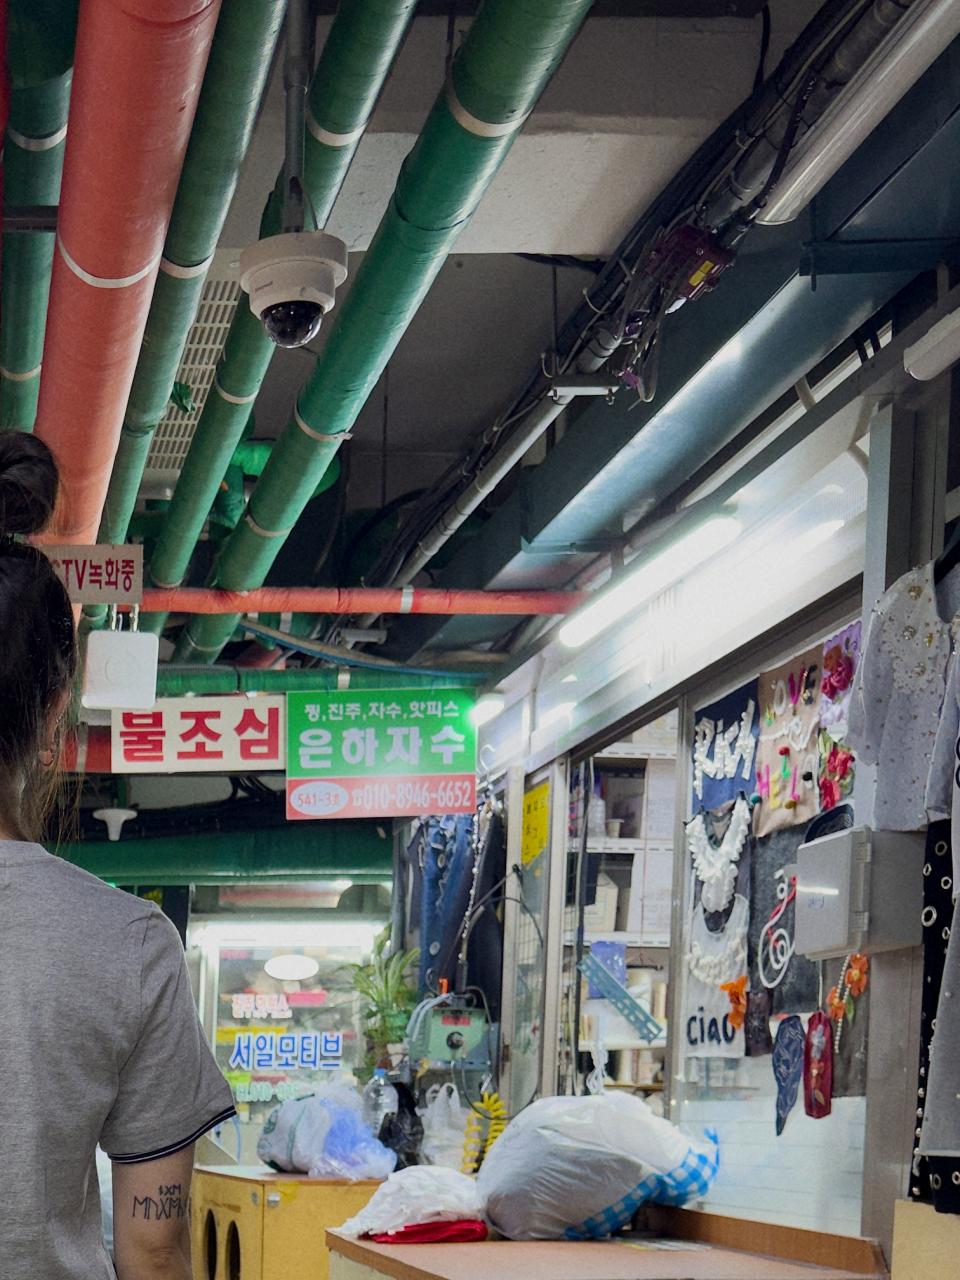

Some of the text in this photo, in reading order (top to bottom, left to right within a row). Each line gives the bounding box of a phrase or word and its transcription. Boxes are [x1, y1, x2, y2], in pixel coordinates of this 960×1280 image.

[49, 558, 135, 592] TV녹화중
[120, 706, 280, 763] 불조심
[298, 725, 466, 769] 은하자수
[231, 1033, 341, 1069] 서일모티브
